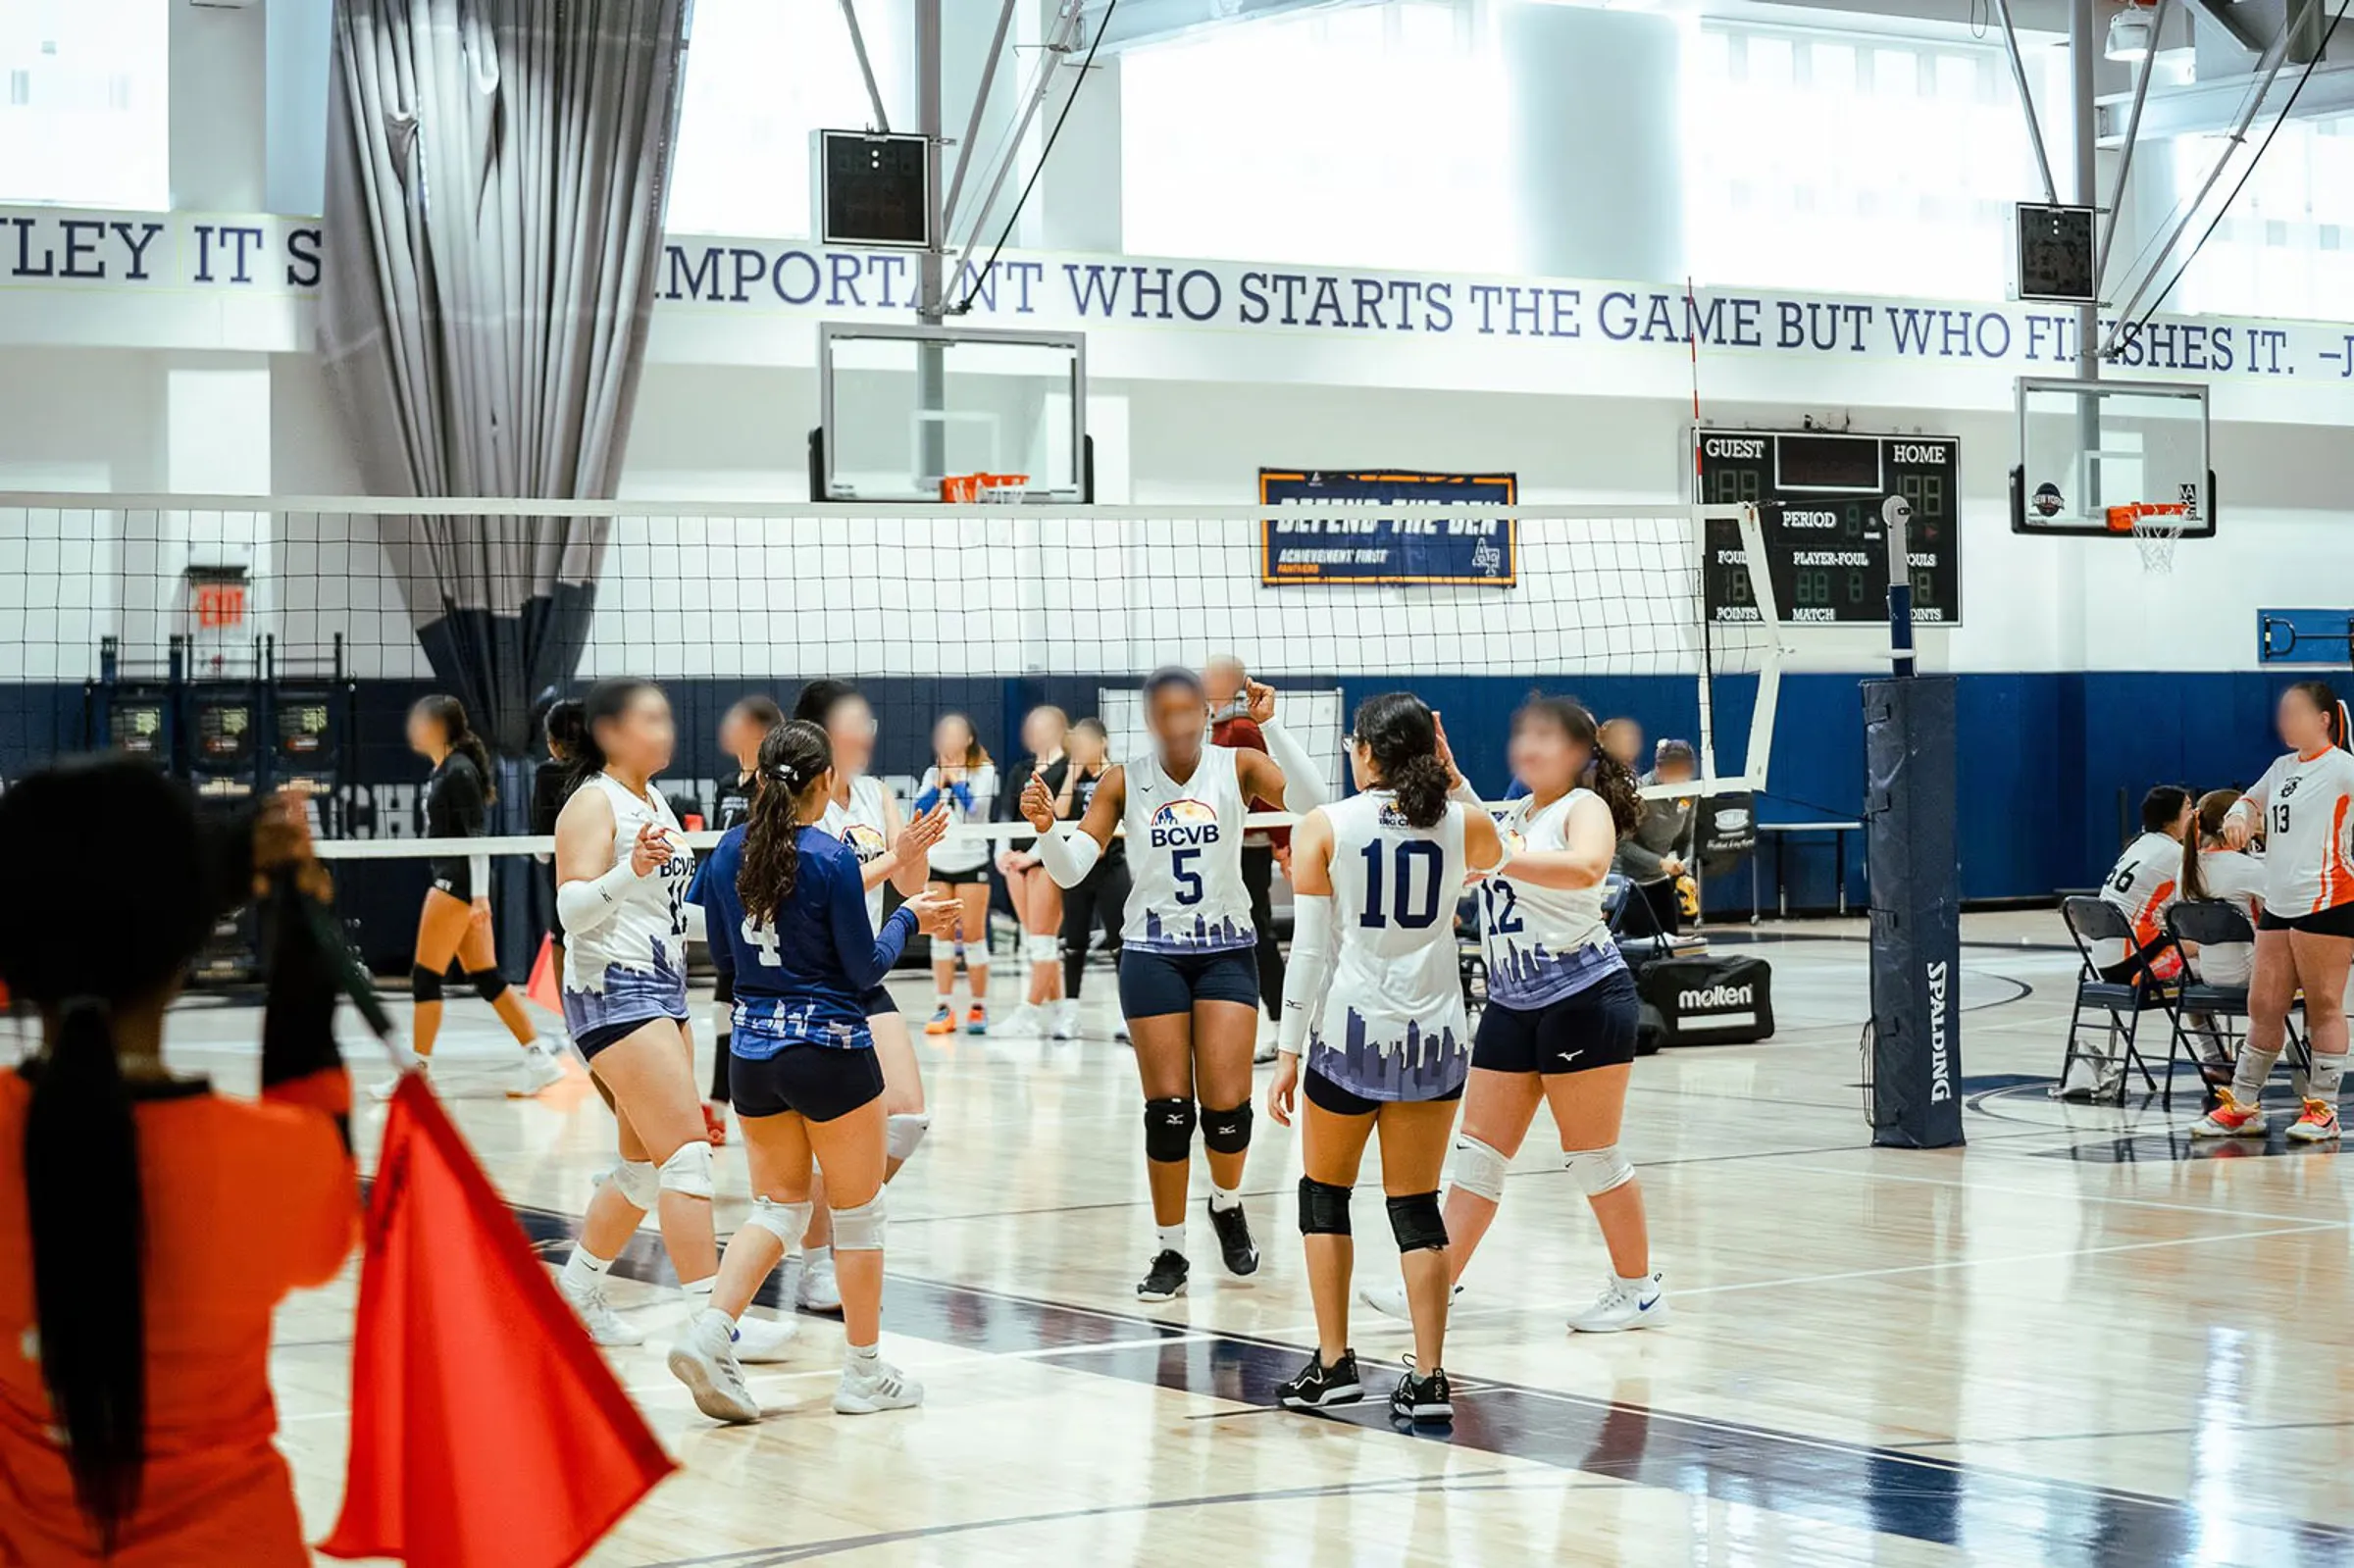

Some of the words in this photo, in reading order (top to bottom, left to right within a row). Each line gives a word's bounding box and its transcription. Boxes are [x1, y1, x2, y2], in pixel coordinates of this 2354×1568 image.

[0, 218, 164, 279] LEY
[194, 225, 263, 282] IT
[655, 245, 1043, 313] MPORTNT
[1062, 263, 1222, 322] WHO
[1240, 272, 1454, 332] STARTS
[1468, 284, 1581, 337] THE
[1598, 292, 1763, 347] GAME
[1776, 301, 1872, 351] BUT
[1885, 308, 2011, 359] WHO
[2247, 329, 2293, 374] IT.
[1706, 438, 1766, 458] GUEST
[1893, 445, 1947, 464] HOME
[1781, 511, 1837, 528] PERIOD
[1278, 548, 1355, 564] ACHIEVEMENT
[1355, 549, 1389, 564] FIRST
[1717, 550, 1748, 565] FOUL
[1793, 551, 1868, 566] PLAYER-FOUL
[1907, 553, 1937, 567] OULS
[200, 590, 244, 627] EXIT
[1716, 606, 1759, 621] POINTS
[1792, 608, 1835, 622] MATCH
[1911, 608, 1943, 621] OINTS
[2273, 804, 2290, 834] 13
[1151, 824, 1220, 847] BCVB
[1171, 848, 1203, 905] 5
[1359, 838, 1444, 929] 10
[1481, 878, 1523, 936] 12
[741, 912, 783, 967] 4
[1678, 984, 1752, 1010] molten
[1926, 961, 1952, 1105] SPALDING
